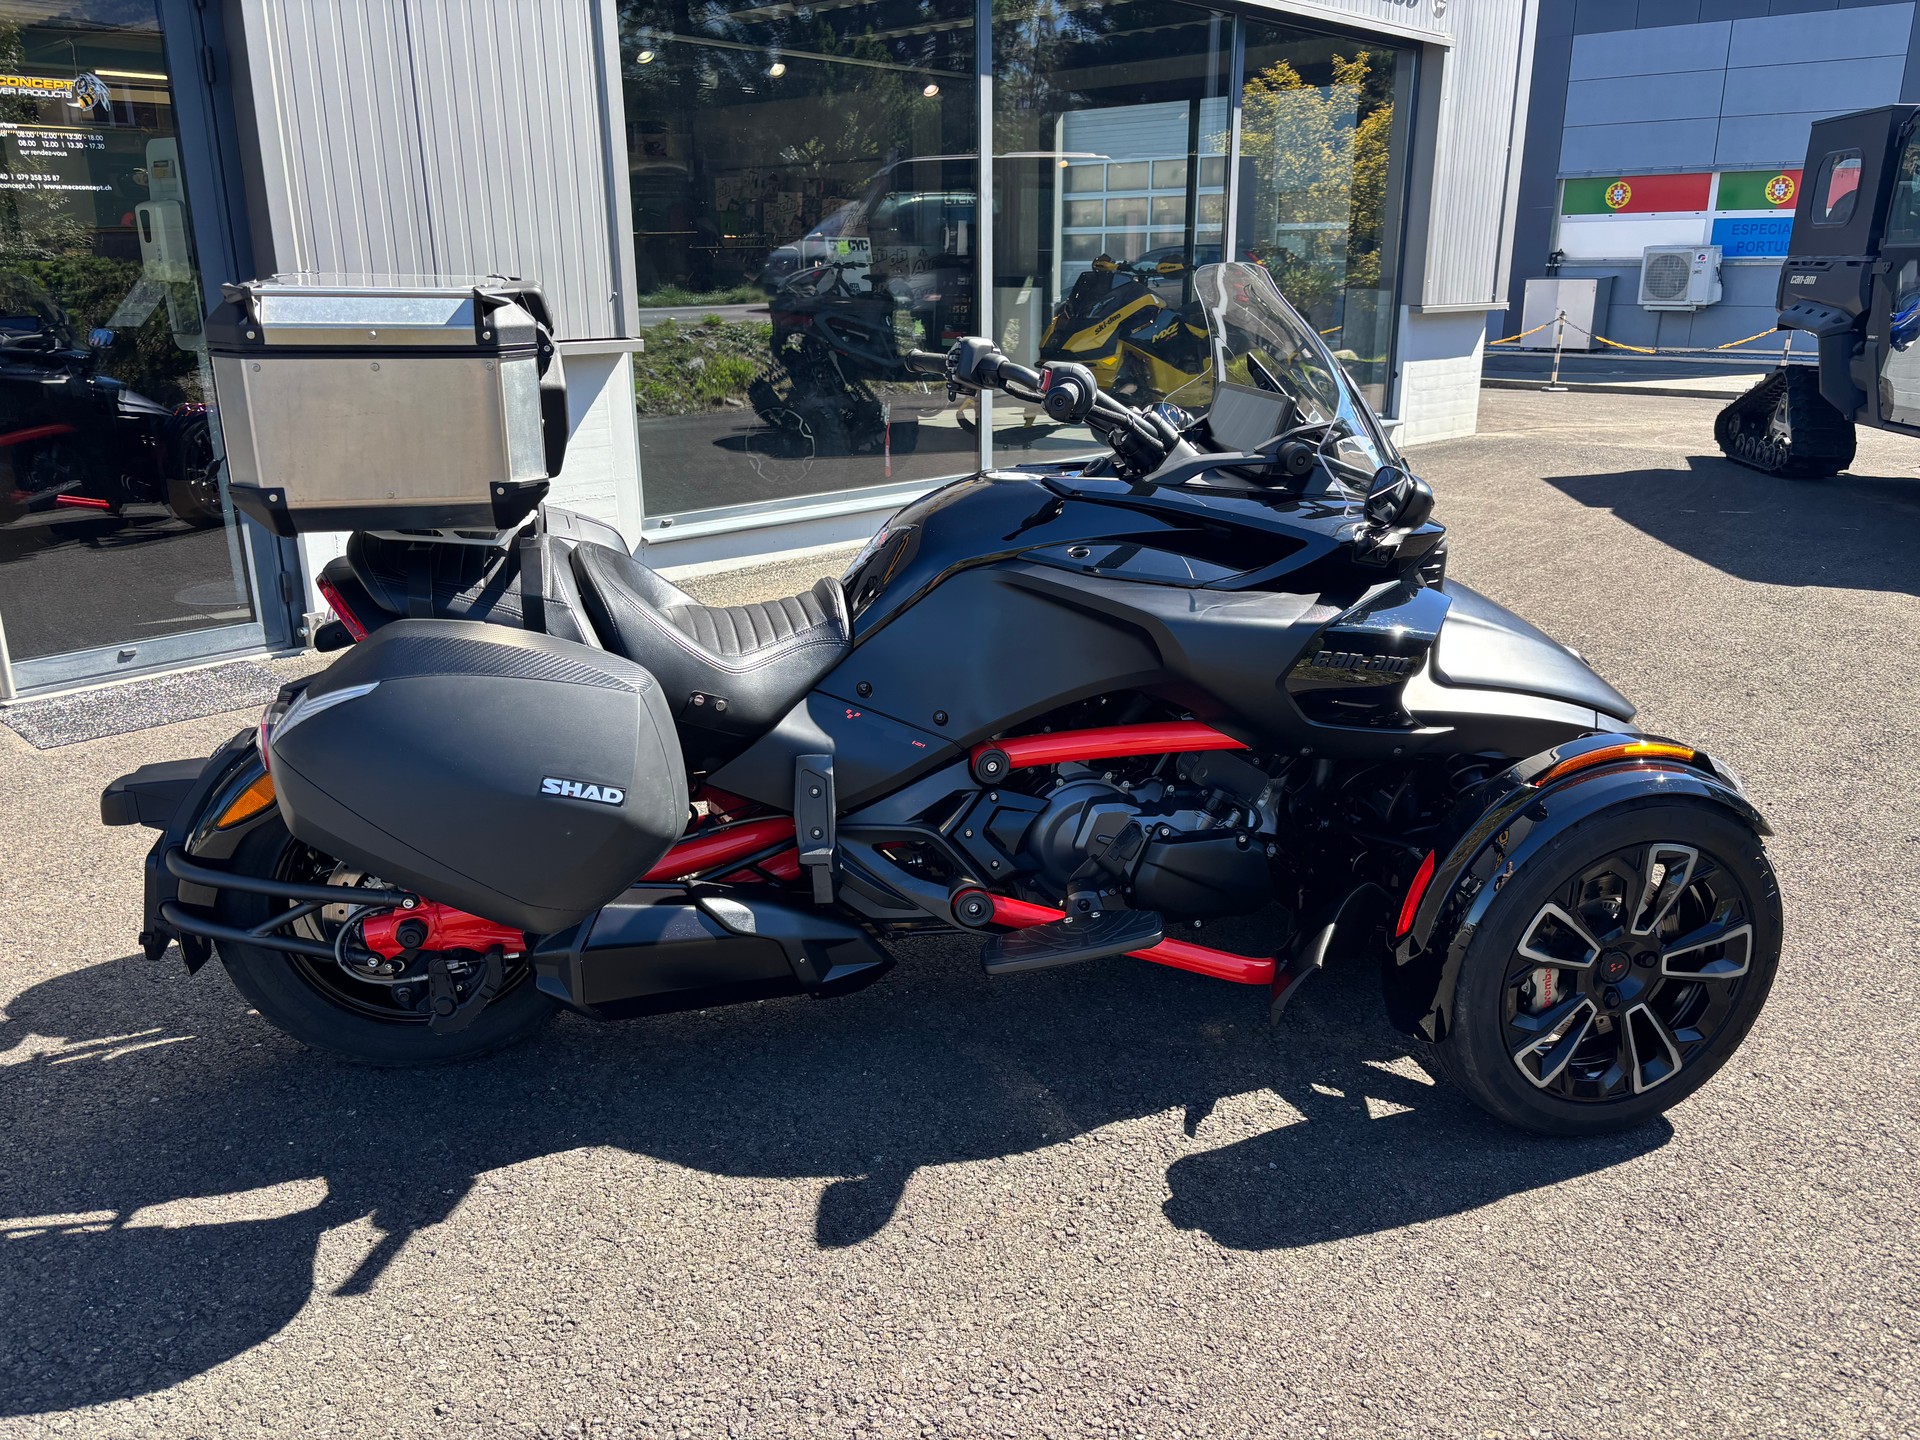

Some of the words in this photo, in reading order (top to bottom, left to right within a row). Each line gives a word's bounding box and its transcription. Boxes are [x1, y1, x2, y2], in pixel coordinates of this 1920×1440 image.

[0, 76, 74, 90] CONCEPT
[19, 89, 72, 98] PRODUCTS
[31, 149, 67, 157] rendez-vous
[43, 184, 112, 192] www.mecaconcept.ch
[1790, 275, 1817, 285] can-am
[1095, 314, 1121, 335] ski-doo
[1152, 322, 1179, 343] MXZ
[1311, 650, 1409, 672] can-am
[541, 778, 624, 804] SHAD
